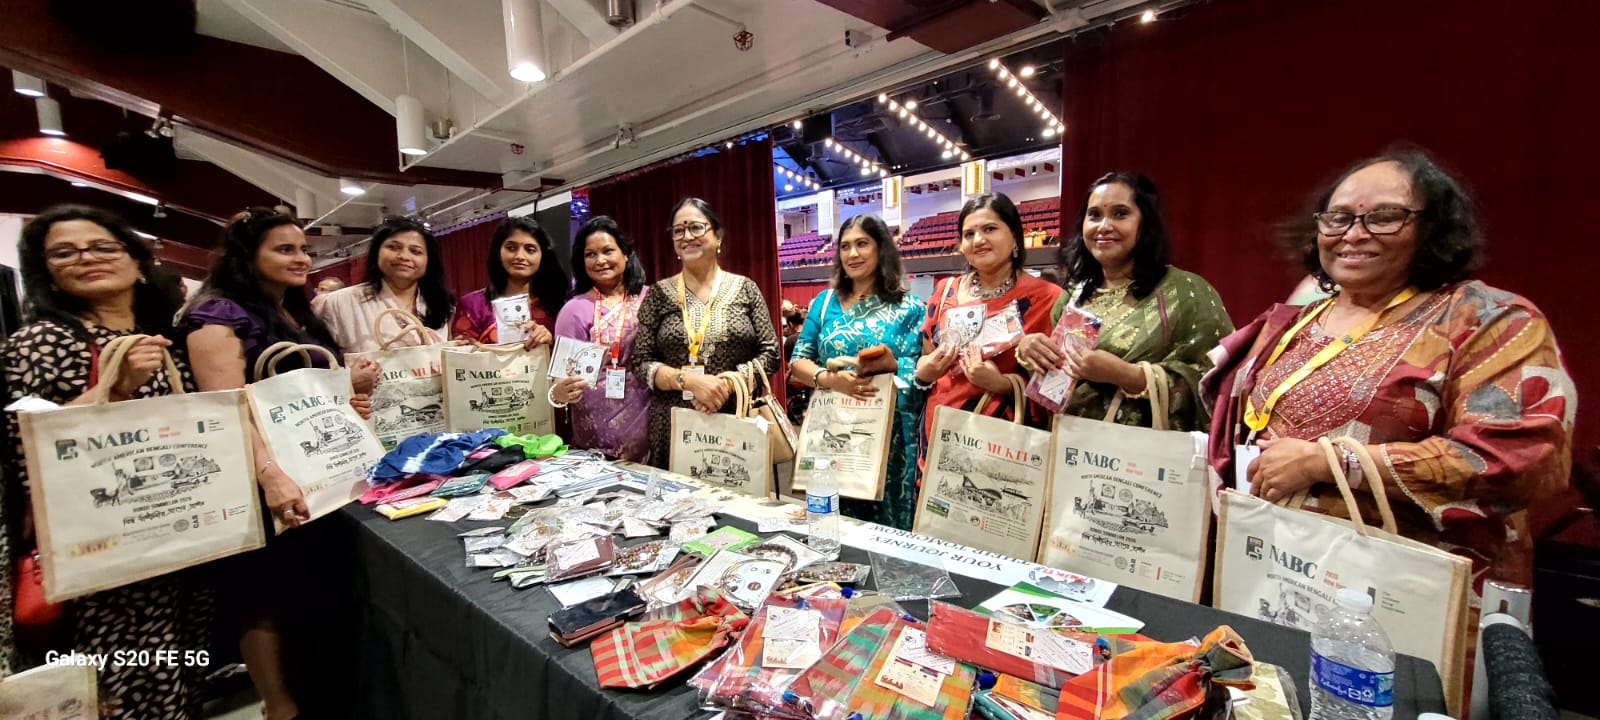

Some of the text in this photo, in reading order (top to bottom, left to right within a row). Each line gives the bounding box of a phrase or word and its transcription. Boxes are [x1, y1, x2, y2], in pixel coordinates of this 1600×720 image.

[381, 368, 408, 381] ABC
[469, 369, 502, 380] NABC
[288, 395, 326, 414] NABC
[818, 397, 837, 407] NABC
[87, 428, 150, 452] NABC
[695, 432, 723, 446] NABC
[954, 432, 984, 450] NABC
[987, 441, 1029, 462] MUKTI
[1083, 450, 1121, 472] NABC
[950, 552, 1002, 571] YOUR
[1129, 558, 1137, 574] CAB
[1269, 544, 1319, 580] NABC
